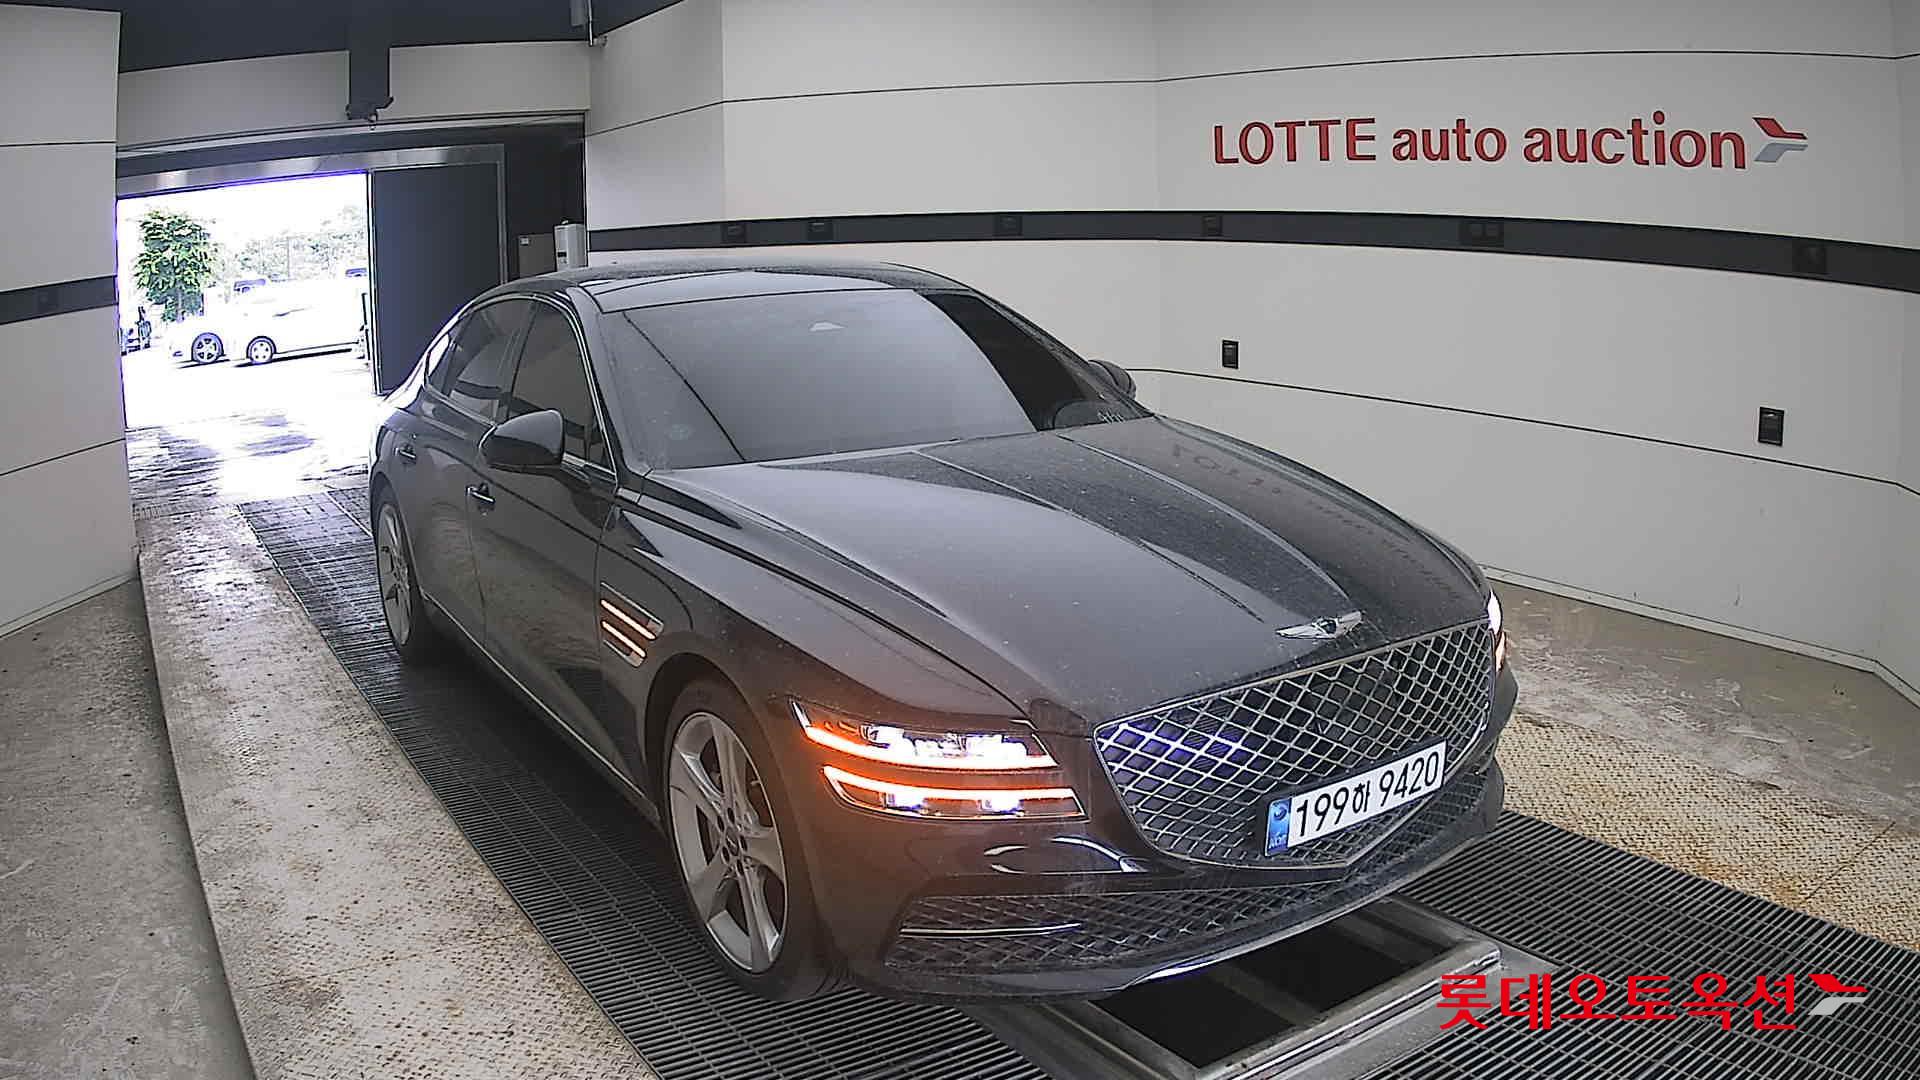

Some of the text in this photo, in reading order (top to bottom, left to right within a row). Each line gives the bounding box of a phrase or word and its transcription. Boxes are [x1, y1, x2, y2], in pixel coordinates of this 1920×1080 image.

[1214, 110, 1746, 169] LOTTE auto auction
[1297, 751, 1439, 836] 199하 9420
